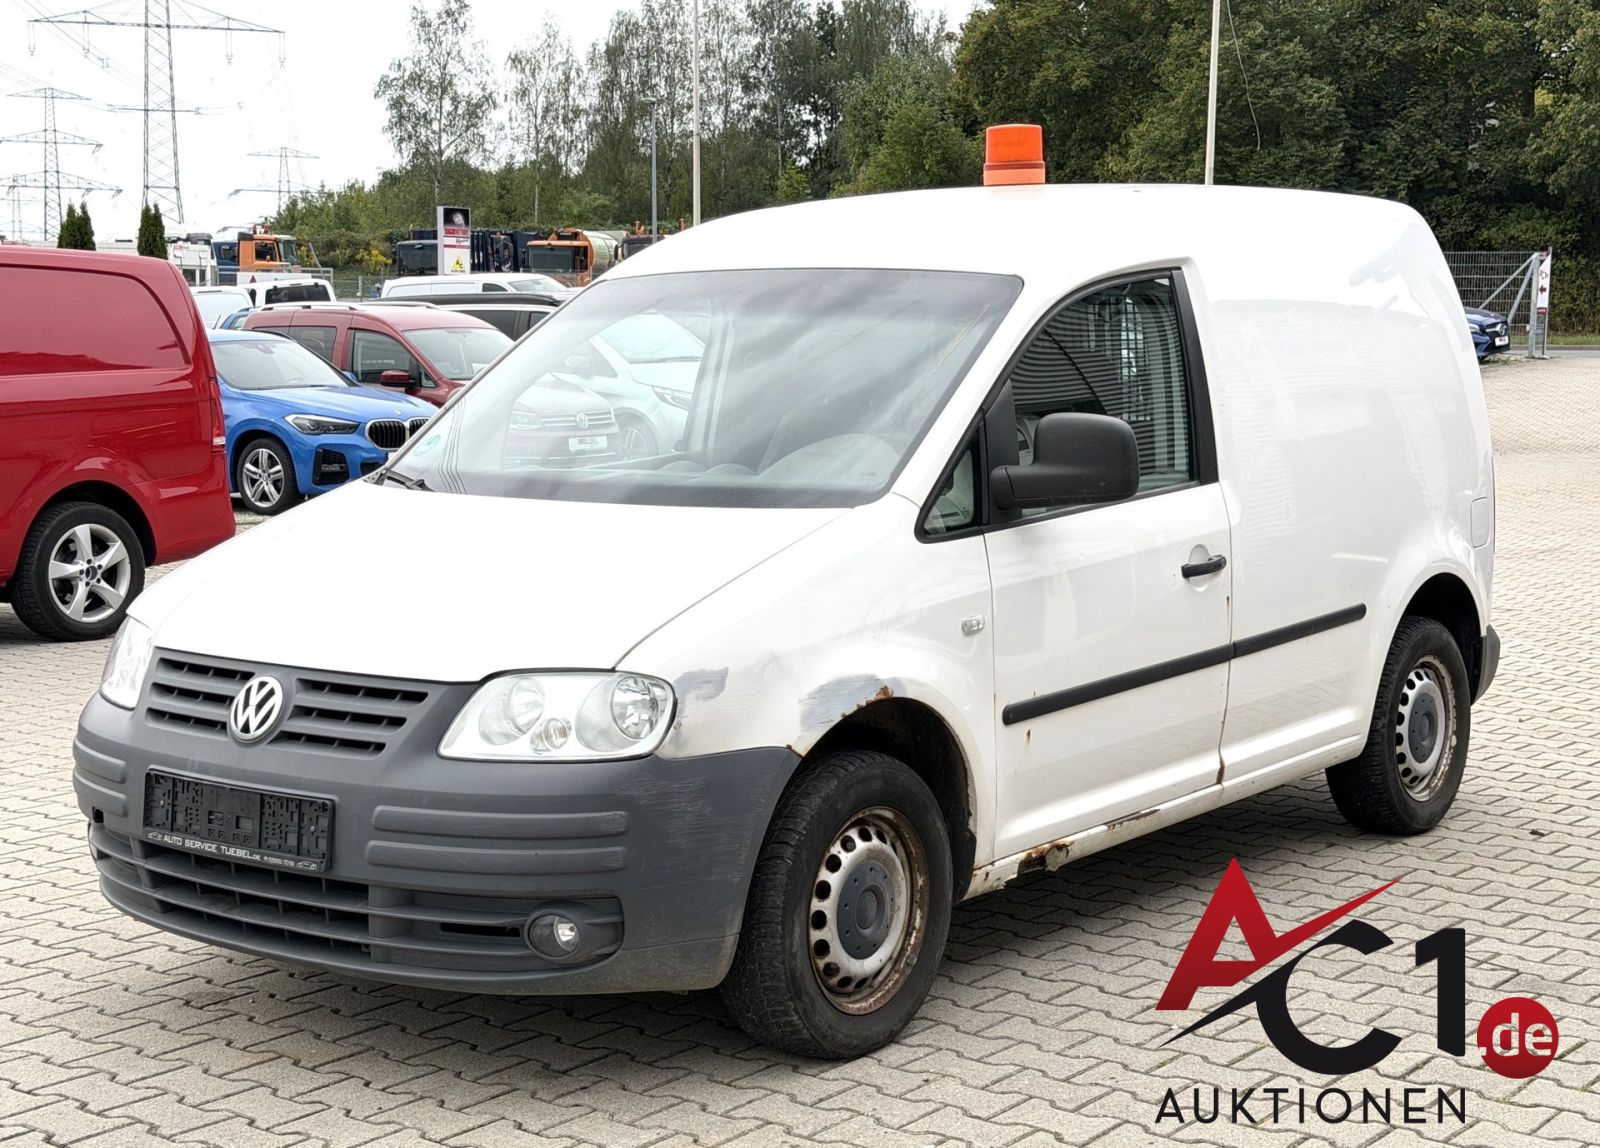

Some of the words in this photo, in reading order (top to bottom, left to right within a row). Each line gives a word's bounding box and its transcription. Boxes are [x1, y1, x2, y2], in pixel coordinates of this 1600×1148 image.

[230, 676, 283, 740] VW
[163, 834, 183, 847] AUTO
[184, 838, 217, 853] SERVICE
